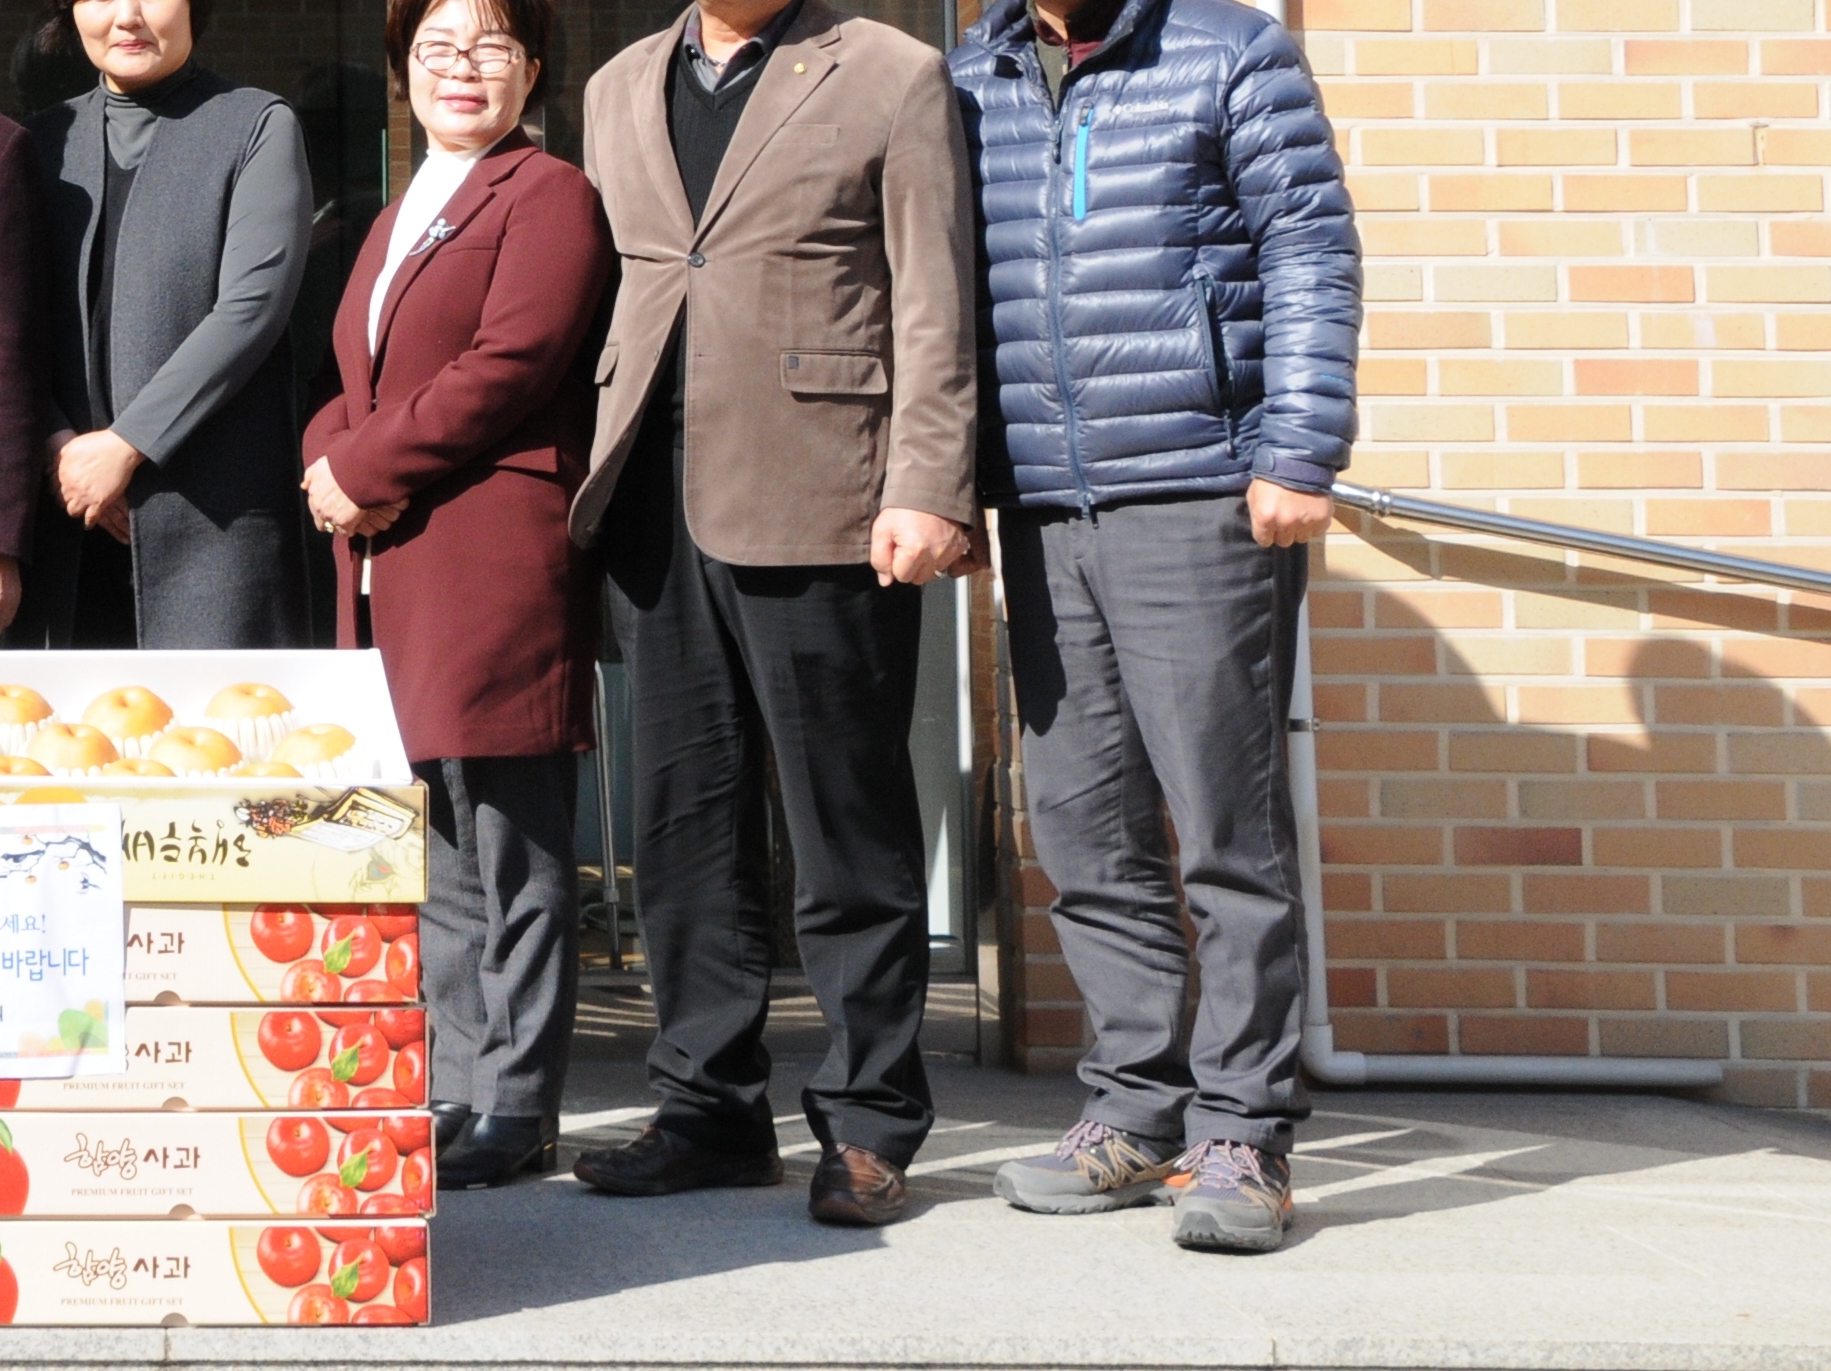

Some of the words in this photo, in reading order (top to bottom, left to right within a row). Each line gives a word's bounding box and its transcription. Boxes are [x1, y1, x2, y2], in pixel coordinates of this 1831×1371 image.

[1, 946, 91, 982] 바랍니다
[135, 972, 158, 981] GIFT
[160, 972, 178, 981] SET
[63, 1081, 110, 1090] PREMIUM
[112, 1081, 140, 1090] FRUIT
[142, 1081, 166, 1090] GIFT
[168, 1081, 186, 1090] SET
[71, 1187, 118, 1196] PREMIUM
[120, 1187, 149, 1196] FRUIT
[151, 1187, 174, 1196] GIFT
[176, 1187, 194, 1196] SET
[60, 1297, 108, 1306] PREMIUM
[109, 1297, 138, 1306] FRUIT
[140, 1297, 164, 1306] GIFT
[166, 1297, 184, 1306] SET
